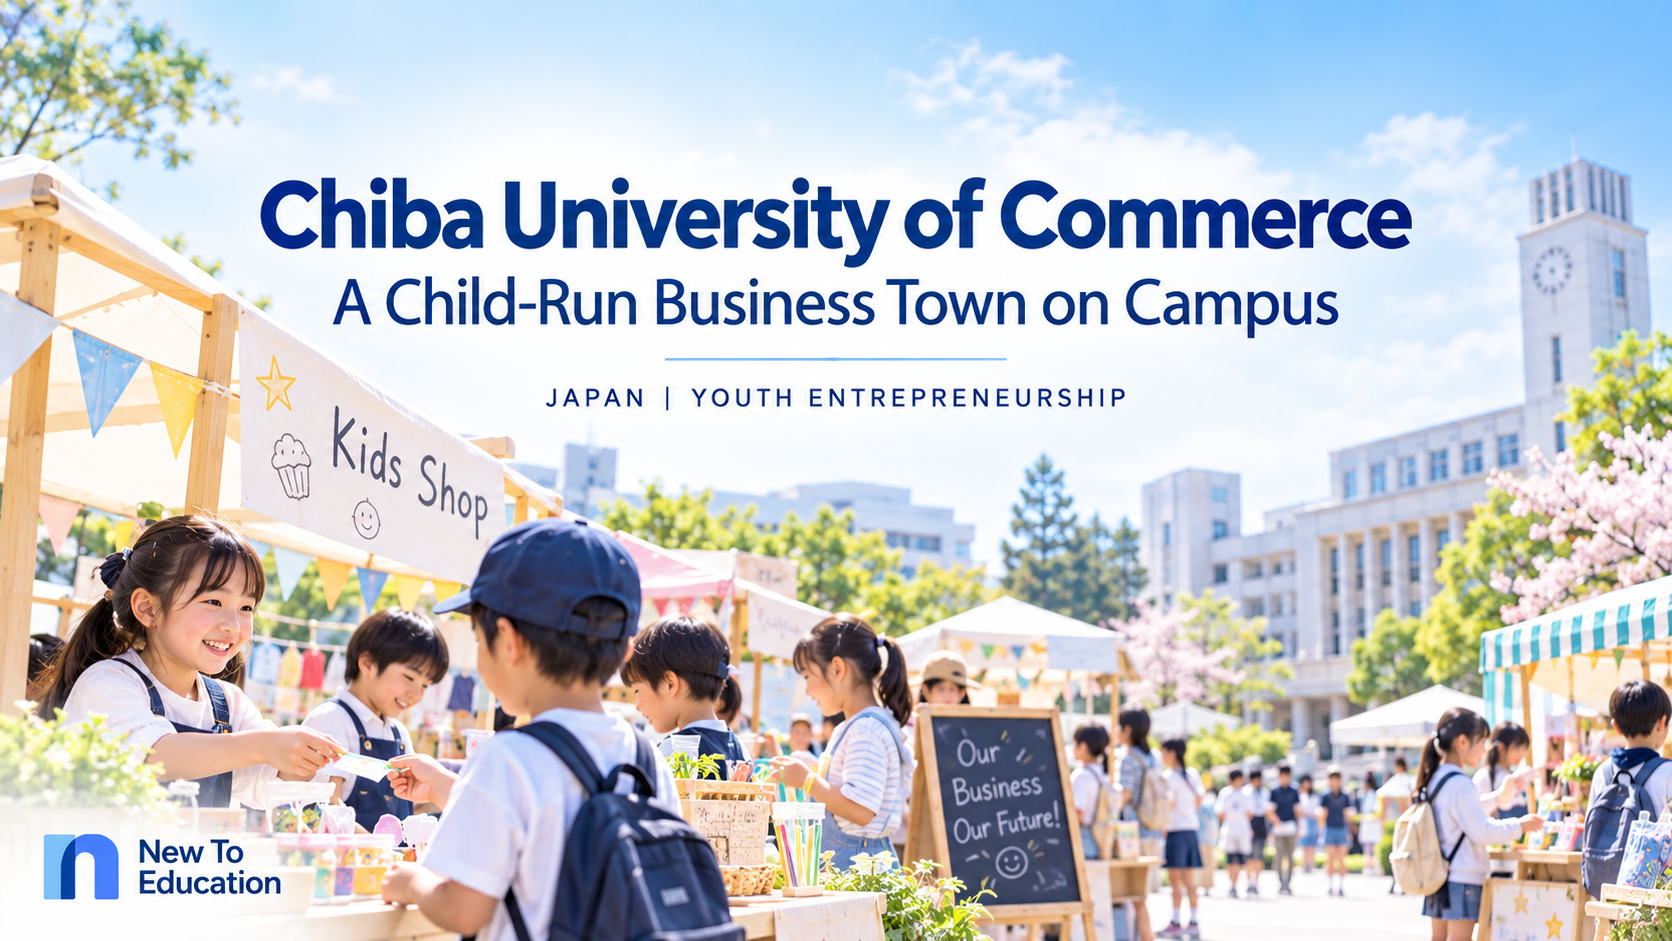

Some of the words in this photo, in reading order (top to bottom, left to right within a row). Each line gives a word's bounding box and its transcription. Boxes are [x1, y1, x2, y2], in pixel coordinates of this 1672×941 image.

[332, 405, 402, 488] Kids
[418, 455, 488, 540] Shop
[957, 738, 1000, 767] Our
[952, 777, 1043, 806] Business
[953, 817, 992, 844] Our
[996, 800, 1061, 836] Future!
